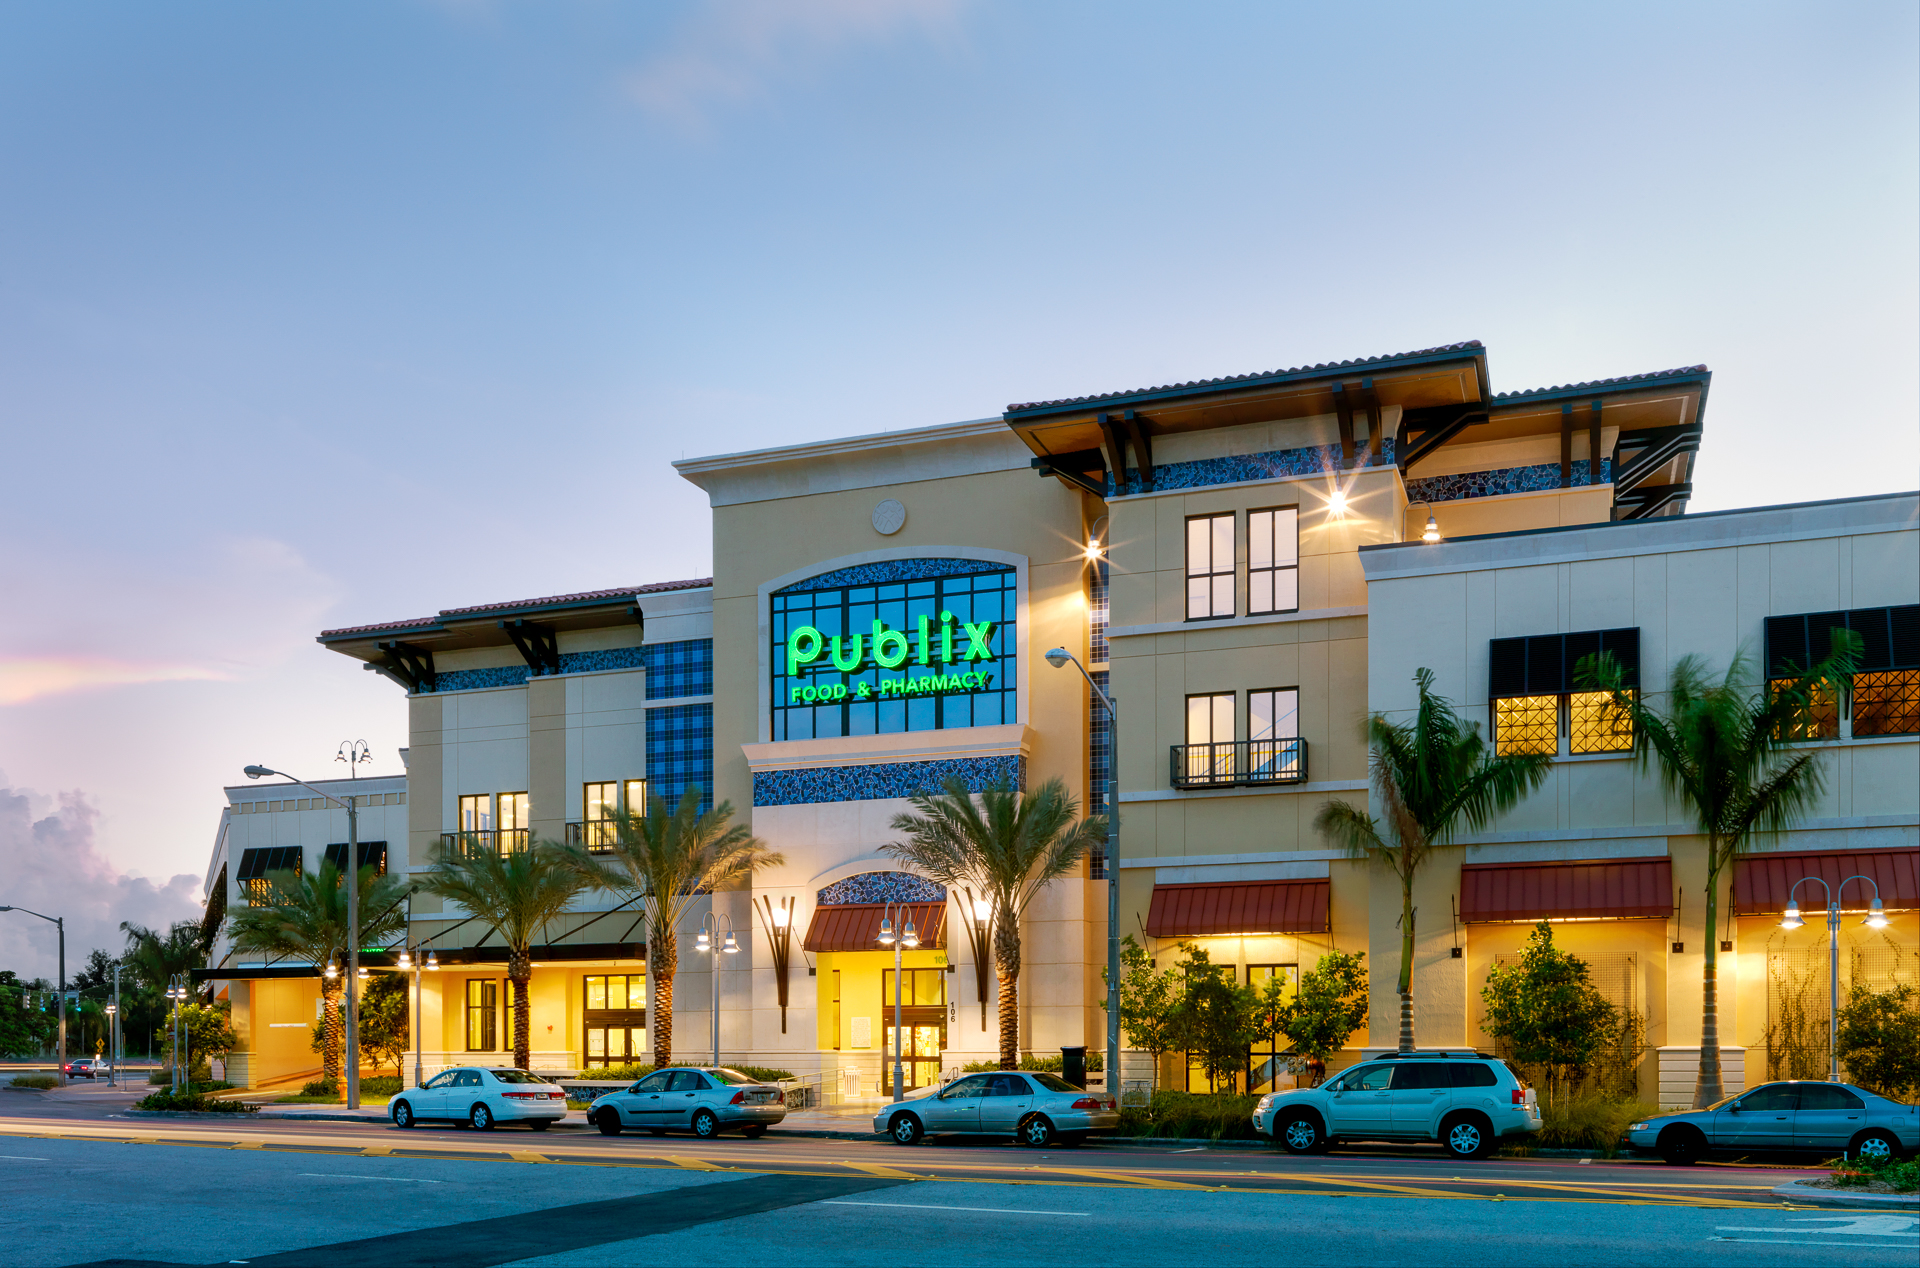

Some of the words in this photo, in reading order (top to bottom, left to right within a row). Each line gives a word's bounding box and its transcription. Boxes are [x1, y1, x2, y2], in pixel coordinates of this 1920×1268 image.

[787, 610, 992, 676] Publix
[791, 684, 847, 703] FOOD
[856, 681, 871, 698] &
[880, 671, 988, 695] PHARMACY
